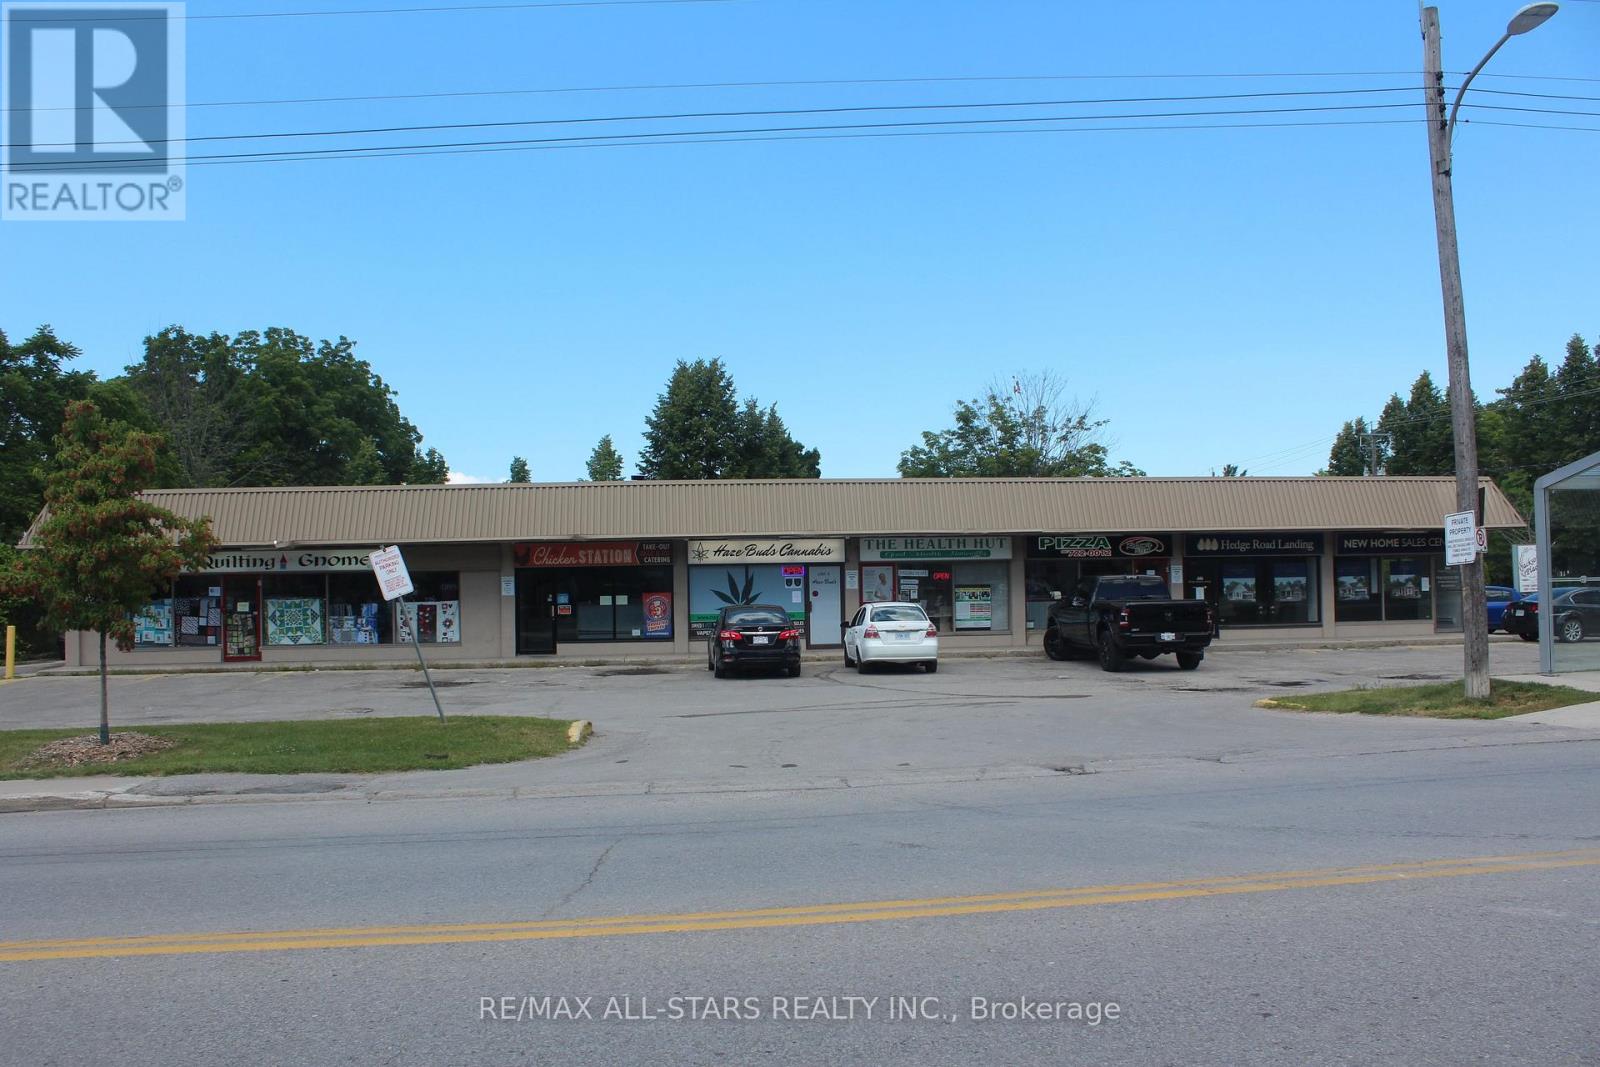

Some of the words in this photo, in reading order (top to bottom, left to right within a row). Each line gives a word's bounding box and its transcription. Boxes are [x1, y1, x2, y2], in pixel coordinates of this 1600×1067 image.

[864, 539, 897, 550] THE
[904, 538, 967, 550] HEALTH
[973, 538, 1006, 549] HUT
[1038, 536, 1112, 550] PIZZA
[1221, 540, 1251, 552] Hedge
[1252, 539, 1276, 549] Road
[1278, 539, 1314, 551] Landing
[1344, 540, 1368, 548] NEW
[1370, 539, 1400, 548] HOME
[1401, 538, 1427, 547] SALES
[533, 546, 577, 565] Chicken
[578, 549, 632, 564] STATION
[713, 544, 744, 557] Haze
[744, 544, 778, 557] Buds
[779, 543, 833, 557] Cannabis
[933, 572, 951, 580] OPEN
